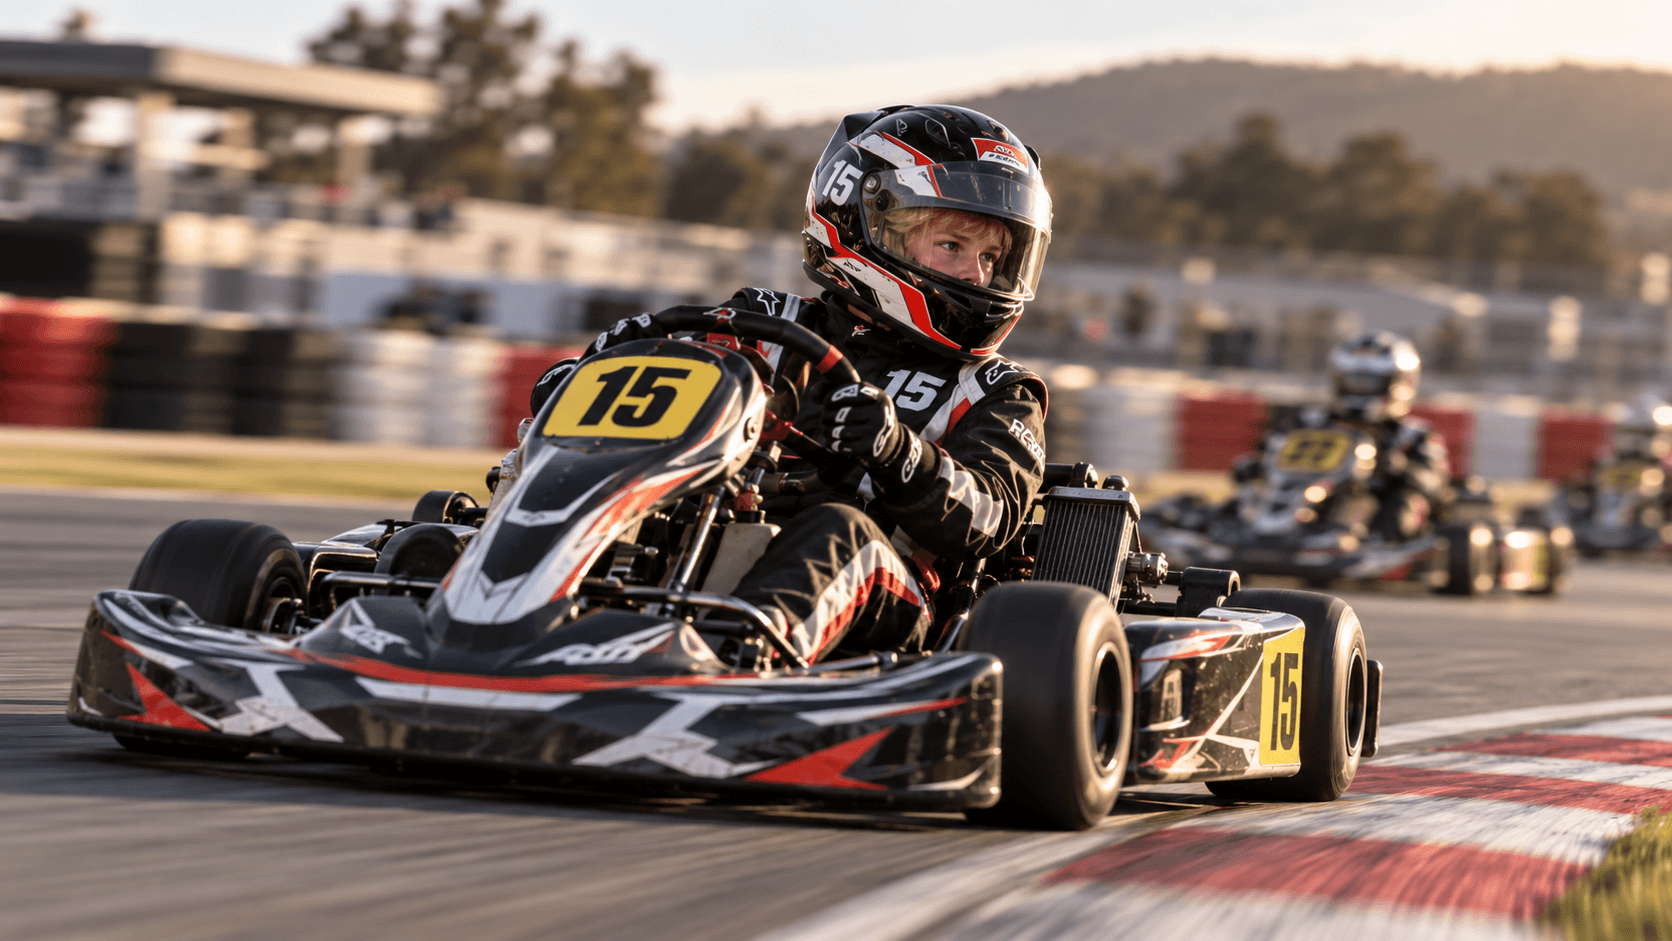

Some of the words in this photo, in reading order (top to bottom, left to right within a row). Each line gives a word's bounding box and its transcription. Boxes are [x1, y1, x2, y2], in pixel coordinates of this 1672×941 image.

[822, 159, 863, 206] 15
[577, 365, 693, 428] 15
[884, 369, 947, 411] 15
[1270, 652, 1299, 751] 15
